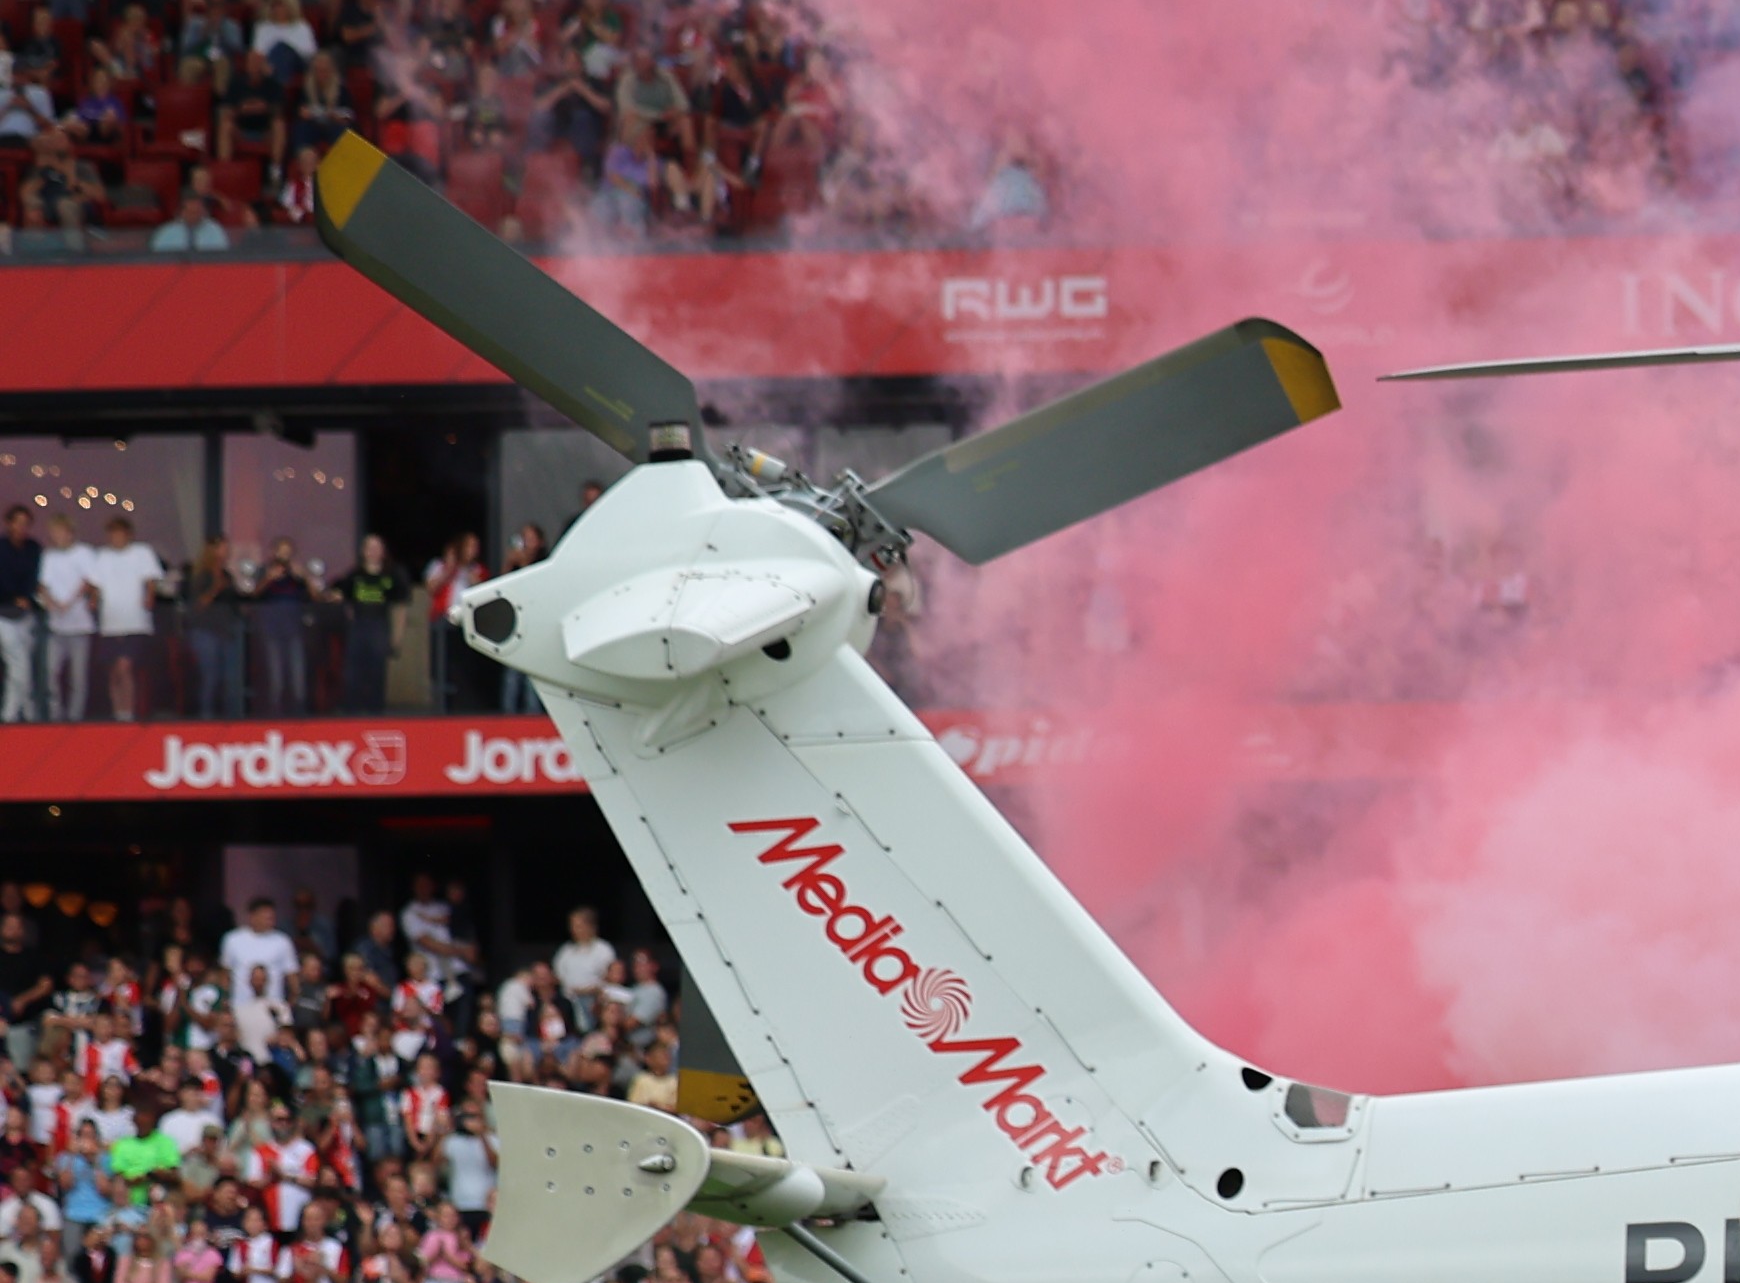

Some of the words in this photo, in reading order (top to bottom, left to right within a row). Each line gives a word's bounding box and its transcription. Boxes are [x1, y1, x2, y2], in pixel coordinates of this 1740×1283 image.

[941, 277, 1107, 318] RWG
[144, 731, 356, 790] Jordex
[446, 731, 580, 784] Jord
[727, 817, 921, 996] Media
[928, 1037, 1110, 1192] Markt
